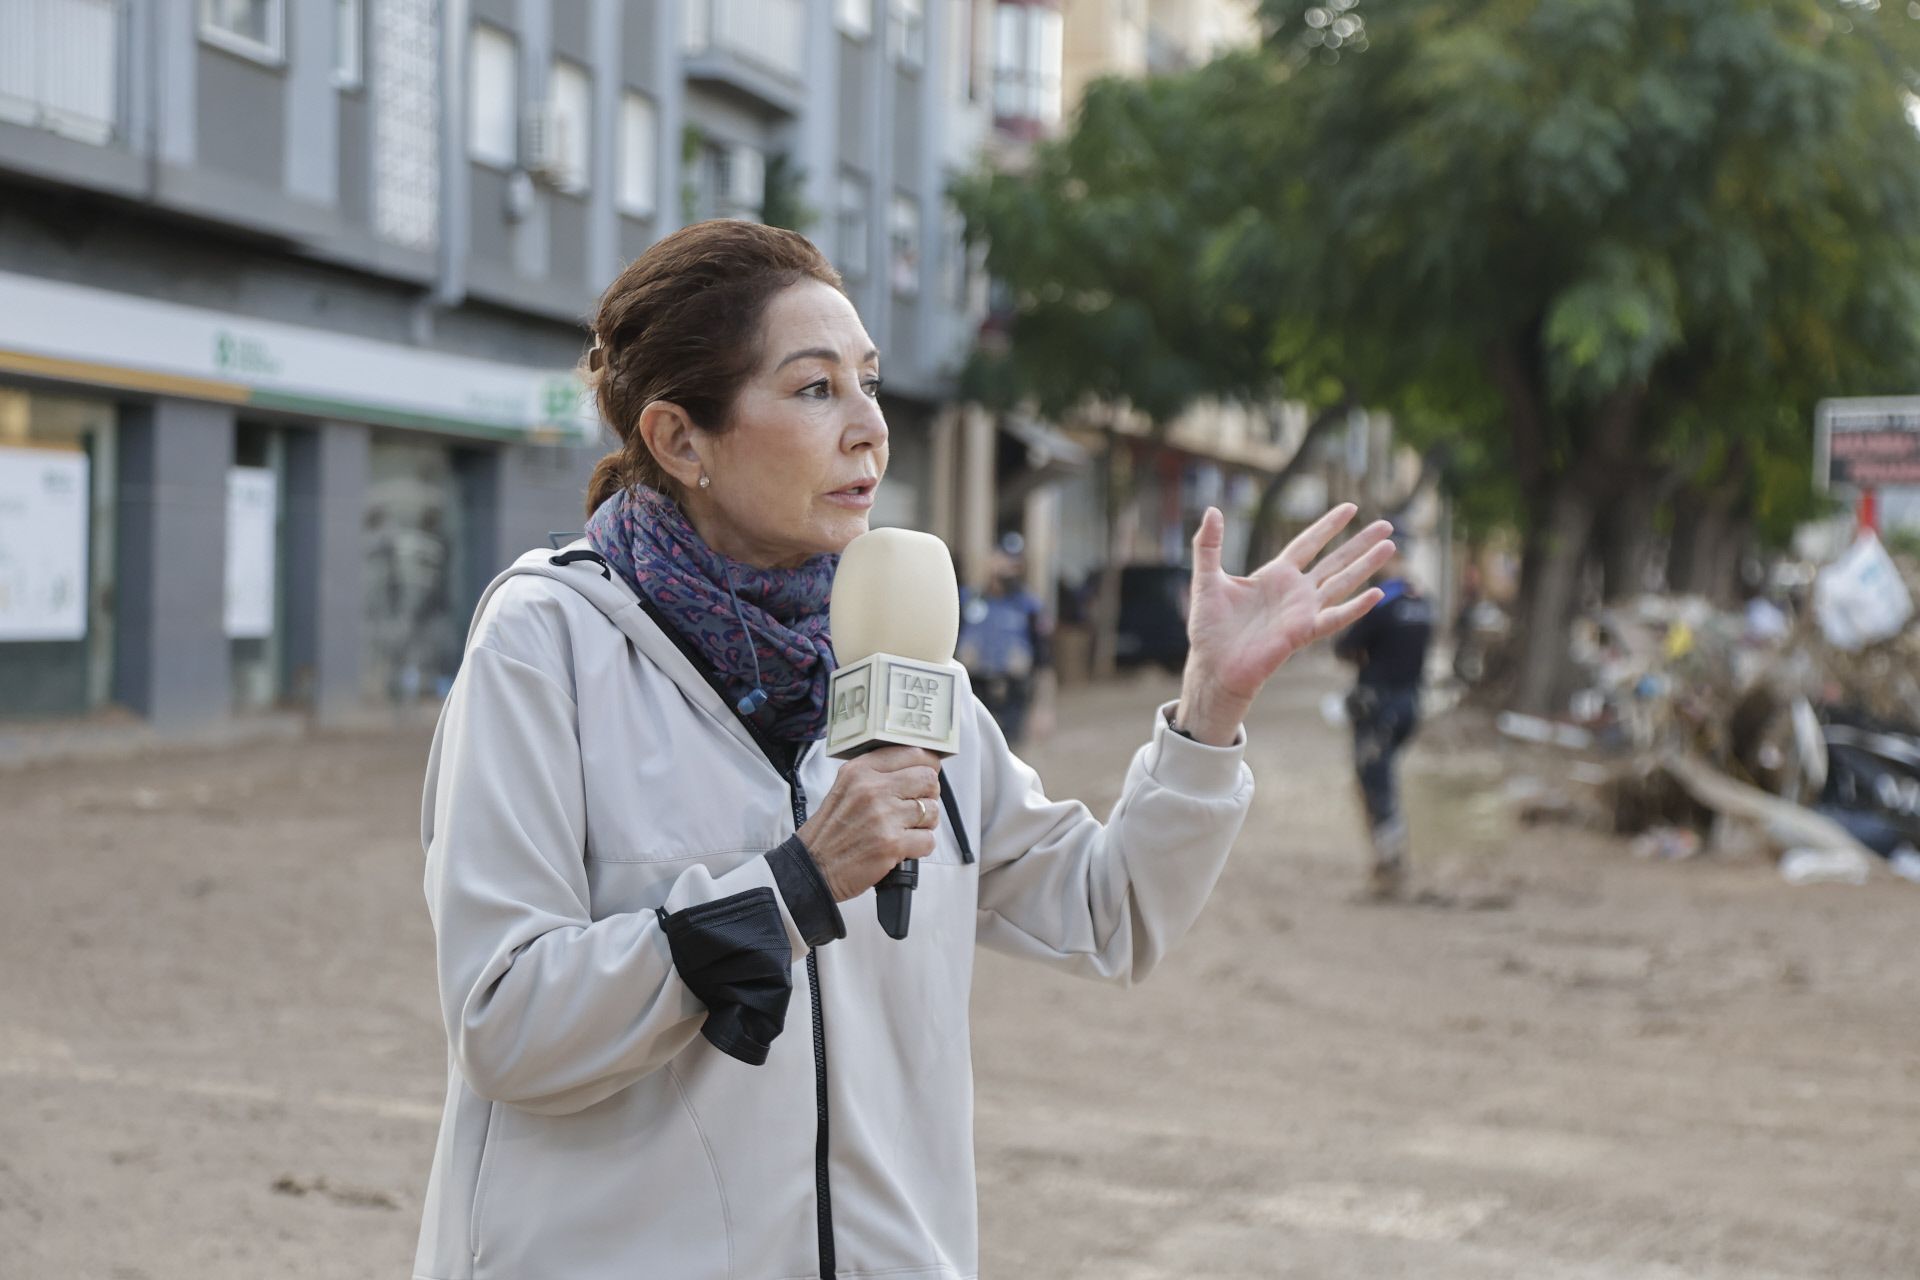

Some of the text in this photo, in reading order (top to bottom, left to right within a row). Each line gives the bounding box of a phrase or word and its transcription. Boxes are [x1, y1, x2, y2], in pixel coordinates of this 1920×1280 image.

[897, 673, 940, 696] TAR
[833, 684, 866, 724] AR
[904, 693, 934, 713] DE
[902, 711, 932, 732] AR
